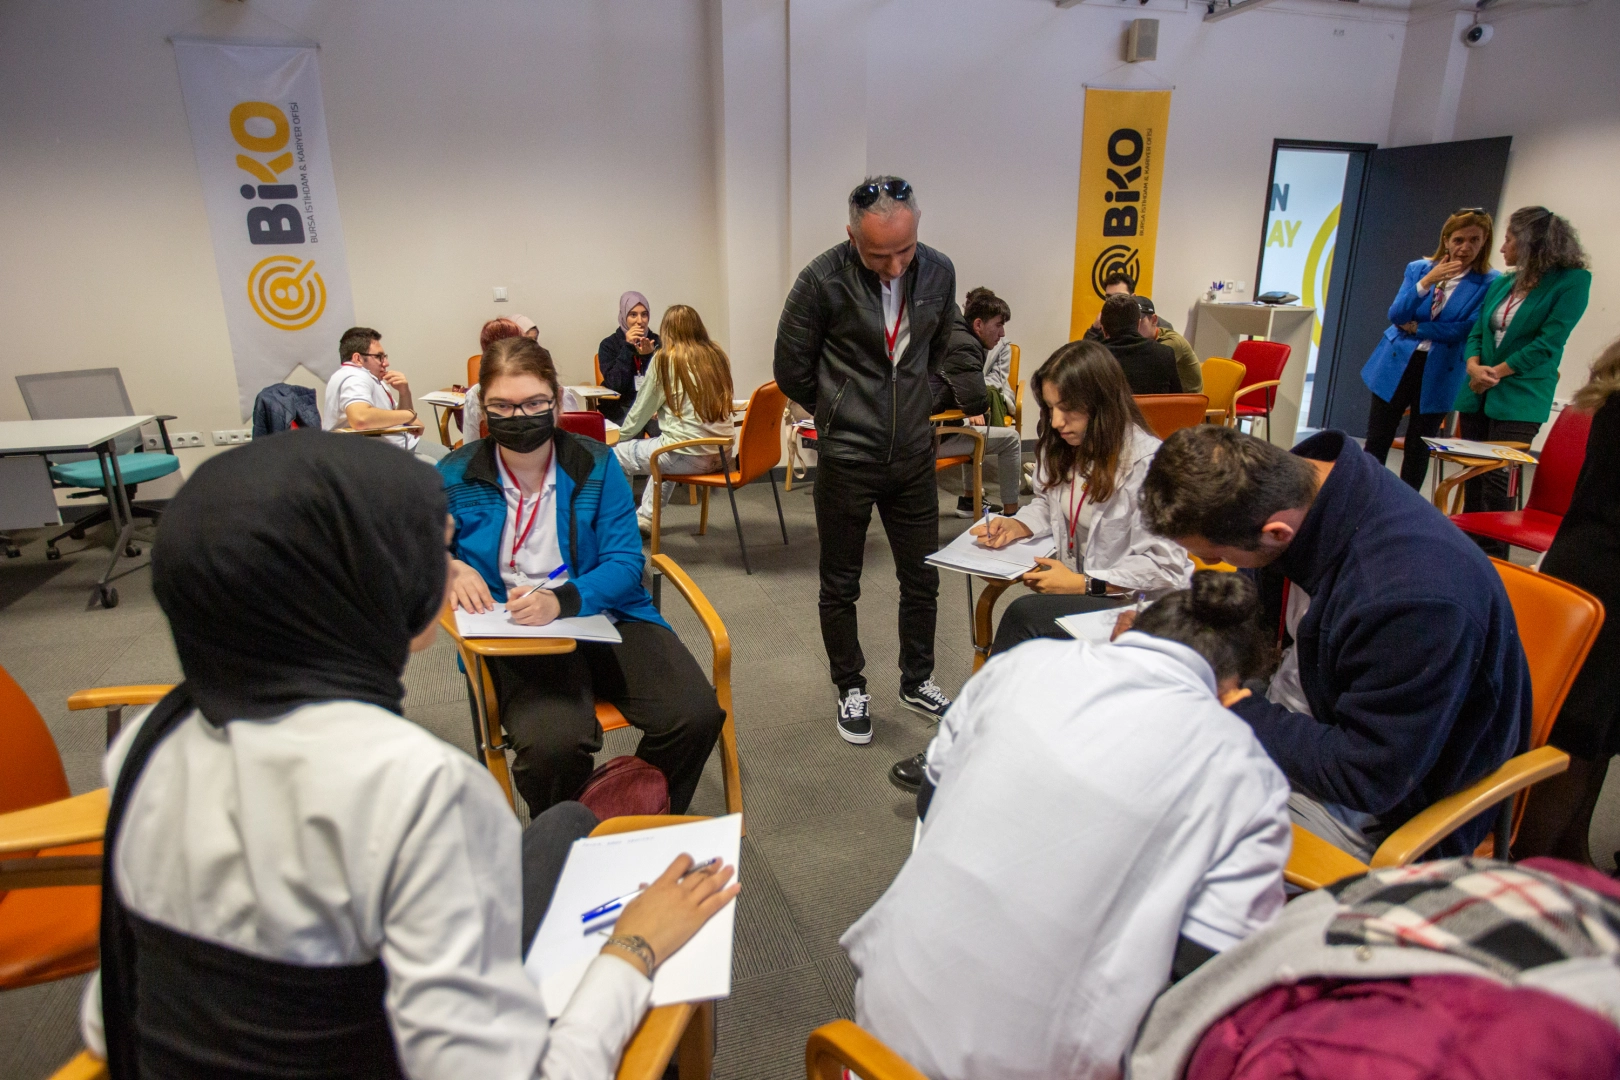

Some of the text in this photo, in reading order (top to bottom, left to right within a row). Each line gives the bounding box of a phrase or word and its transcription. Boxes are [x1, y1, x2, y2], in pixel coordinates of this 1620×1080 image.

[288, 102, 301, 125] OFİSİ
[294, 126, 306, 162] KARİYER
[301, 173, 314, 213] İSTİHDAM
[307, 214, 318, 243] BURSA
